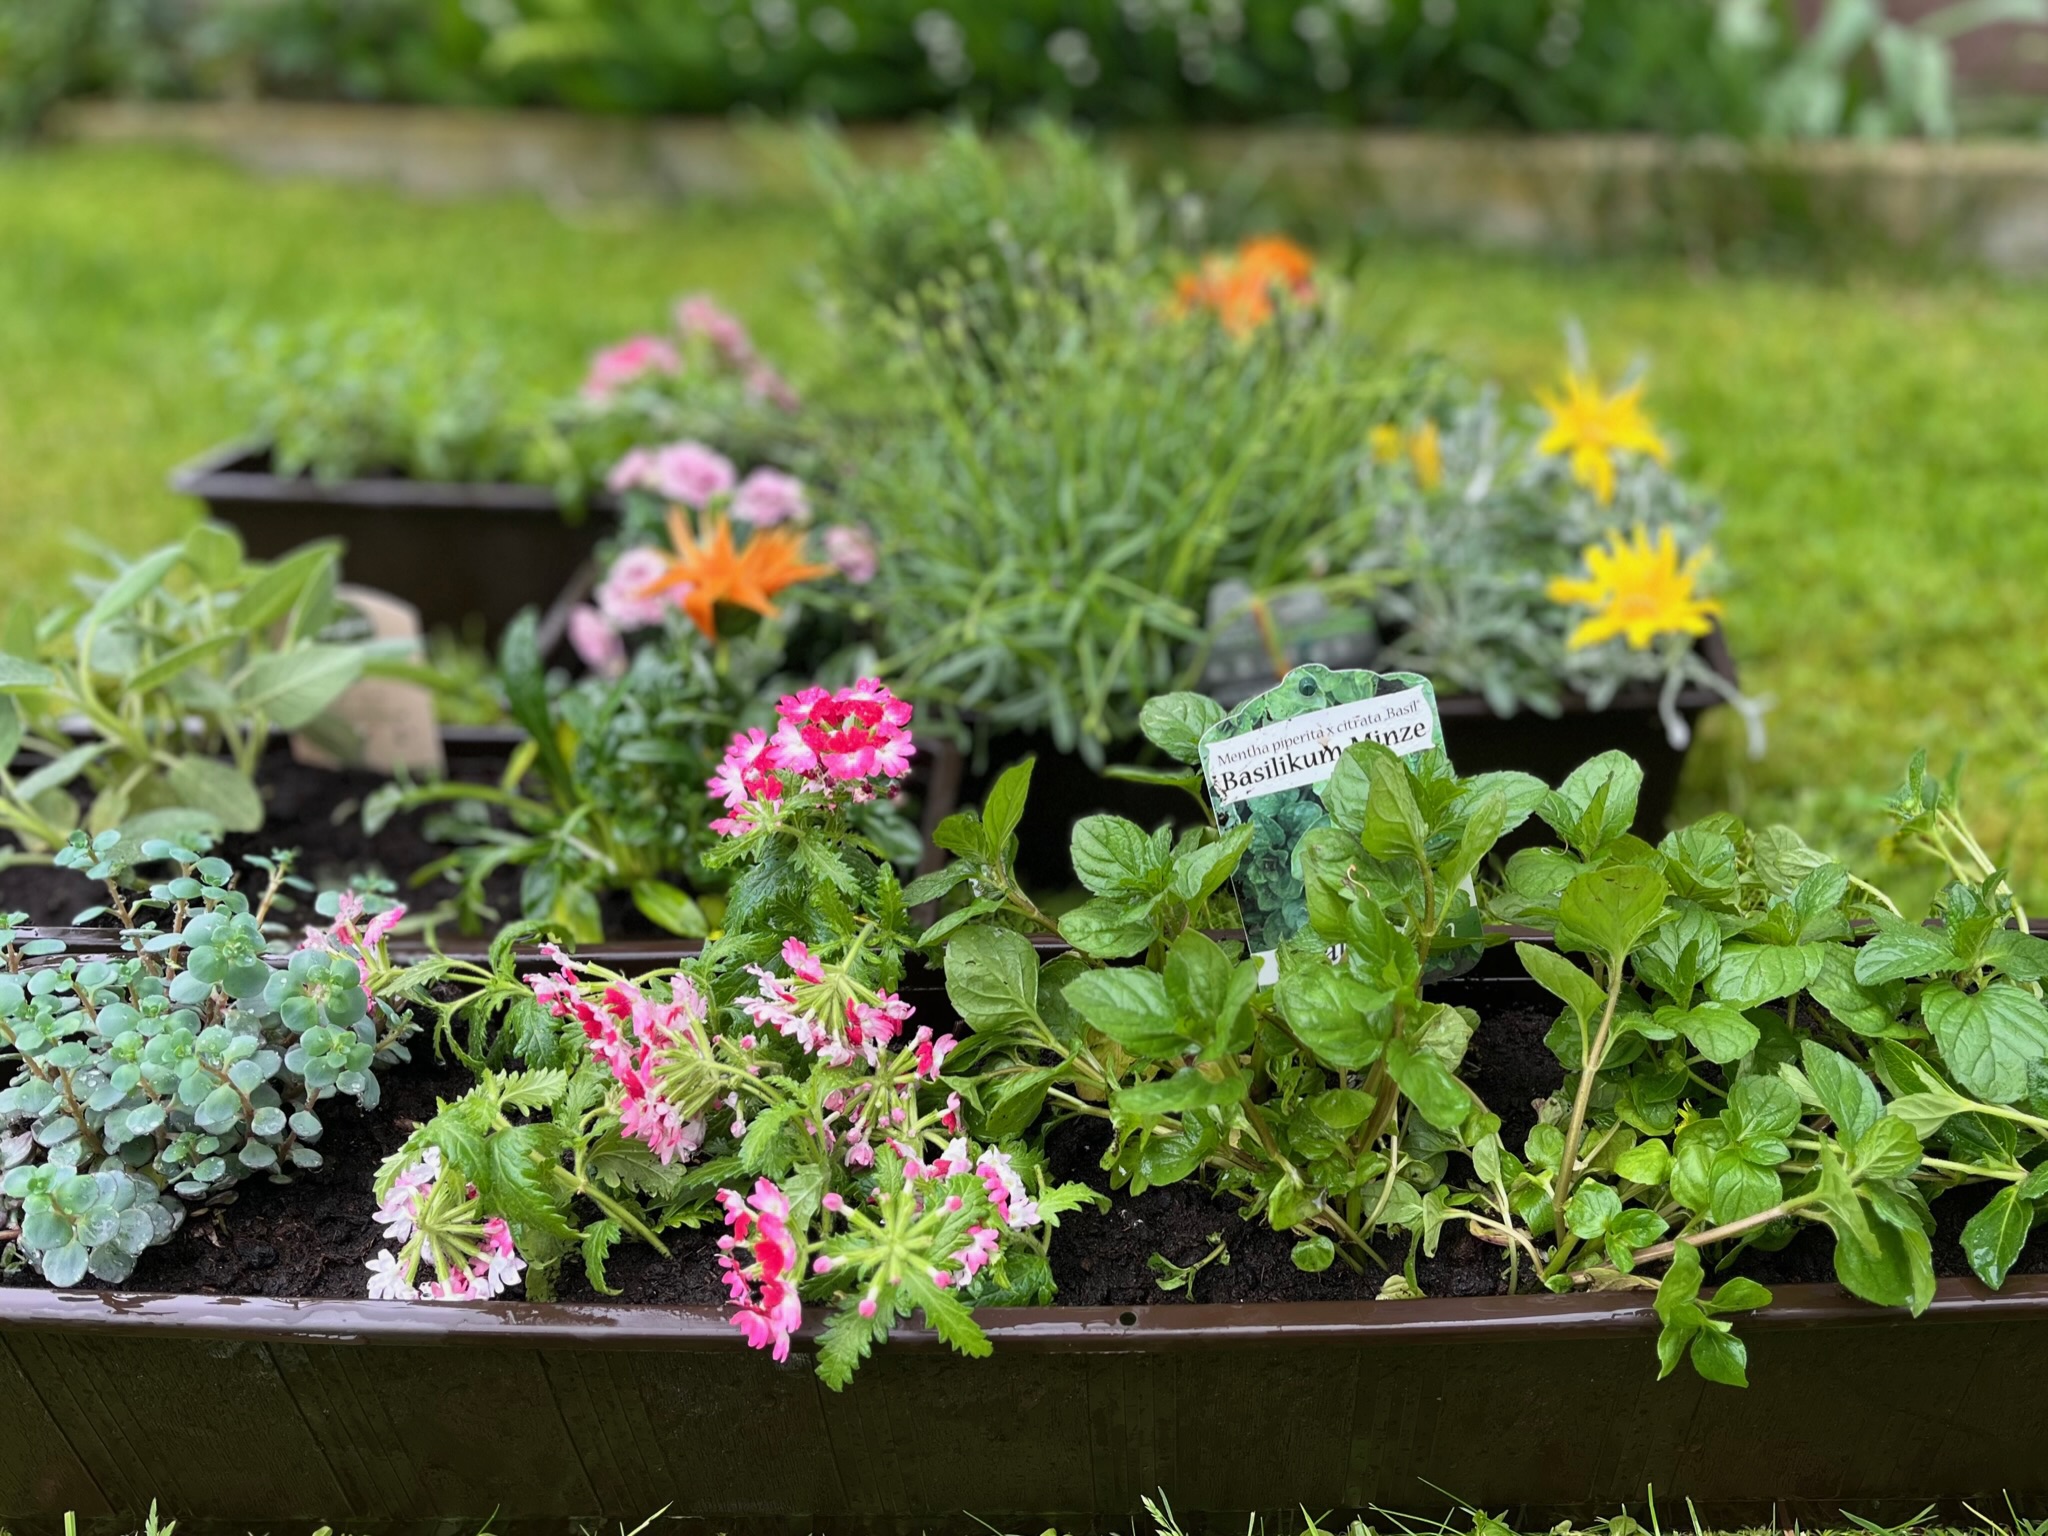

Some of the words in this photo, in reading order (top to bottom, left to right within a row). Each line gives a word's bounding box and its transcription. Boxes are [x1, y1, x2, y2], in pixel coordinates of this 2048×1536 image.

[1217, 745, 1270, 766] Mentha
[1272, 729, 1324, 754] piperita
[1326, 726, 1335, 735] x
[1337, 714, 1382, 733] citrata
[1220, 745, 1342, 791] Basilikum
